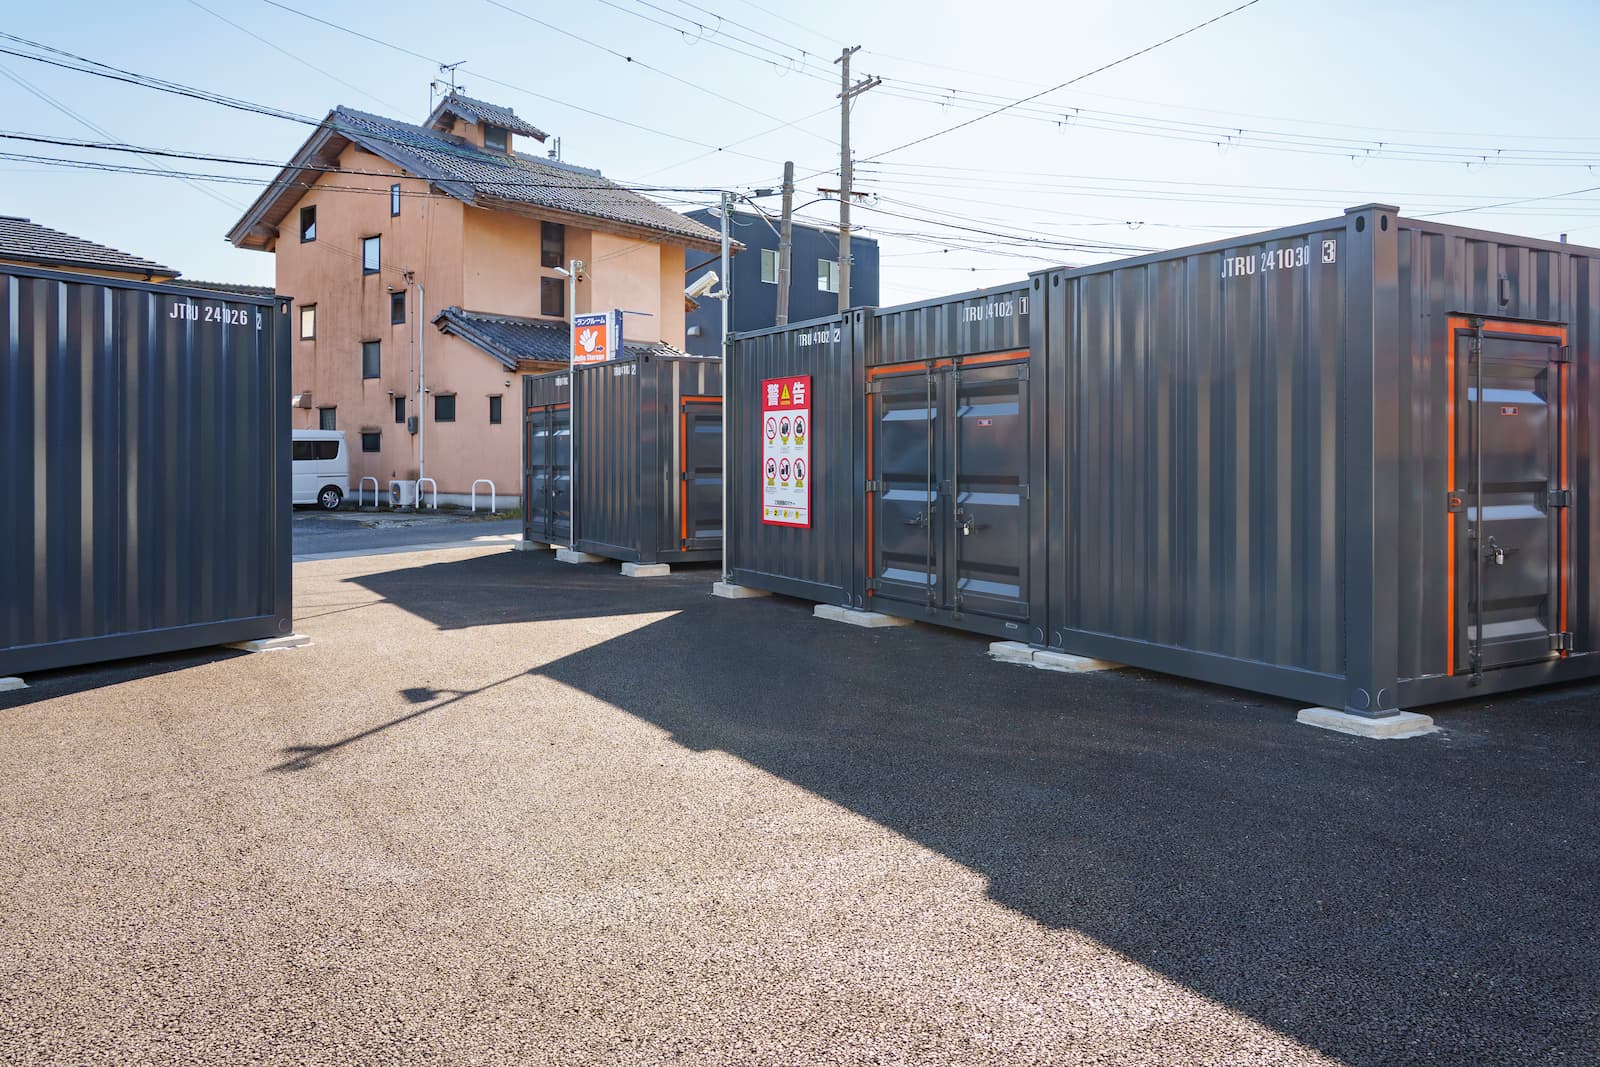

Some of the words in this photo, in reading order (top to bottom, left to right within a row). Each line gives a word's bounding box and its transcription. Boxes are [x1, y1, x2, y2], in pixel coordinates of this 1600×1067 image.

[1221, 254, 1256, 278] JTRU
[1261, 245, 1310, 272] 241030
[1323, 240, 1335, 262] 3
[169, 302, 199, 321] JTRU
[204, 306, 248, 326] 241026
[256, 312, 262, 330] 2
[1019, 297, 1028, 314] 1
